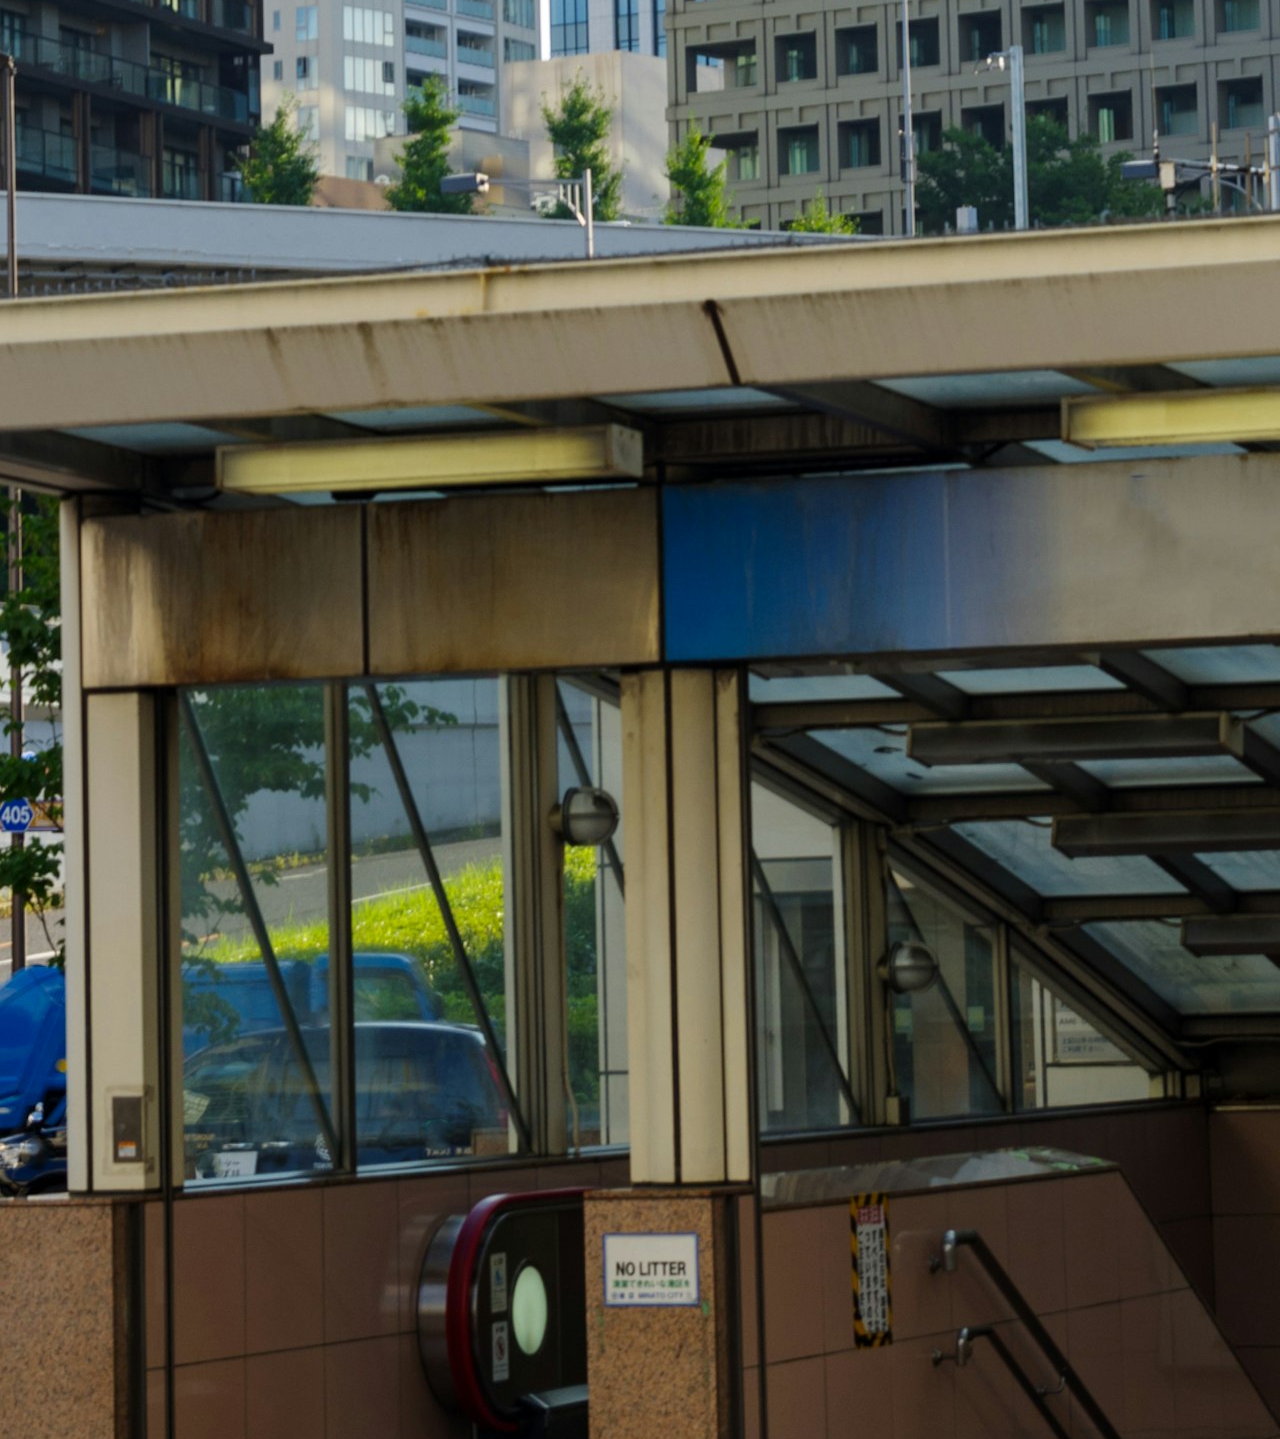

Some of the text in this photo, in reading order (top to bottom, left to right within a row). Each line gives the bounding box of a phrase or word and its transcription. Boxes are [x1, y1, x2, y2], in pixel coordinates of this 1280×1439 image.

[1, 805, 30, 824] 405
[615, 1261, 686, 1276] NO LITTER
